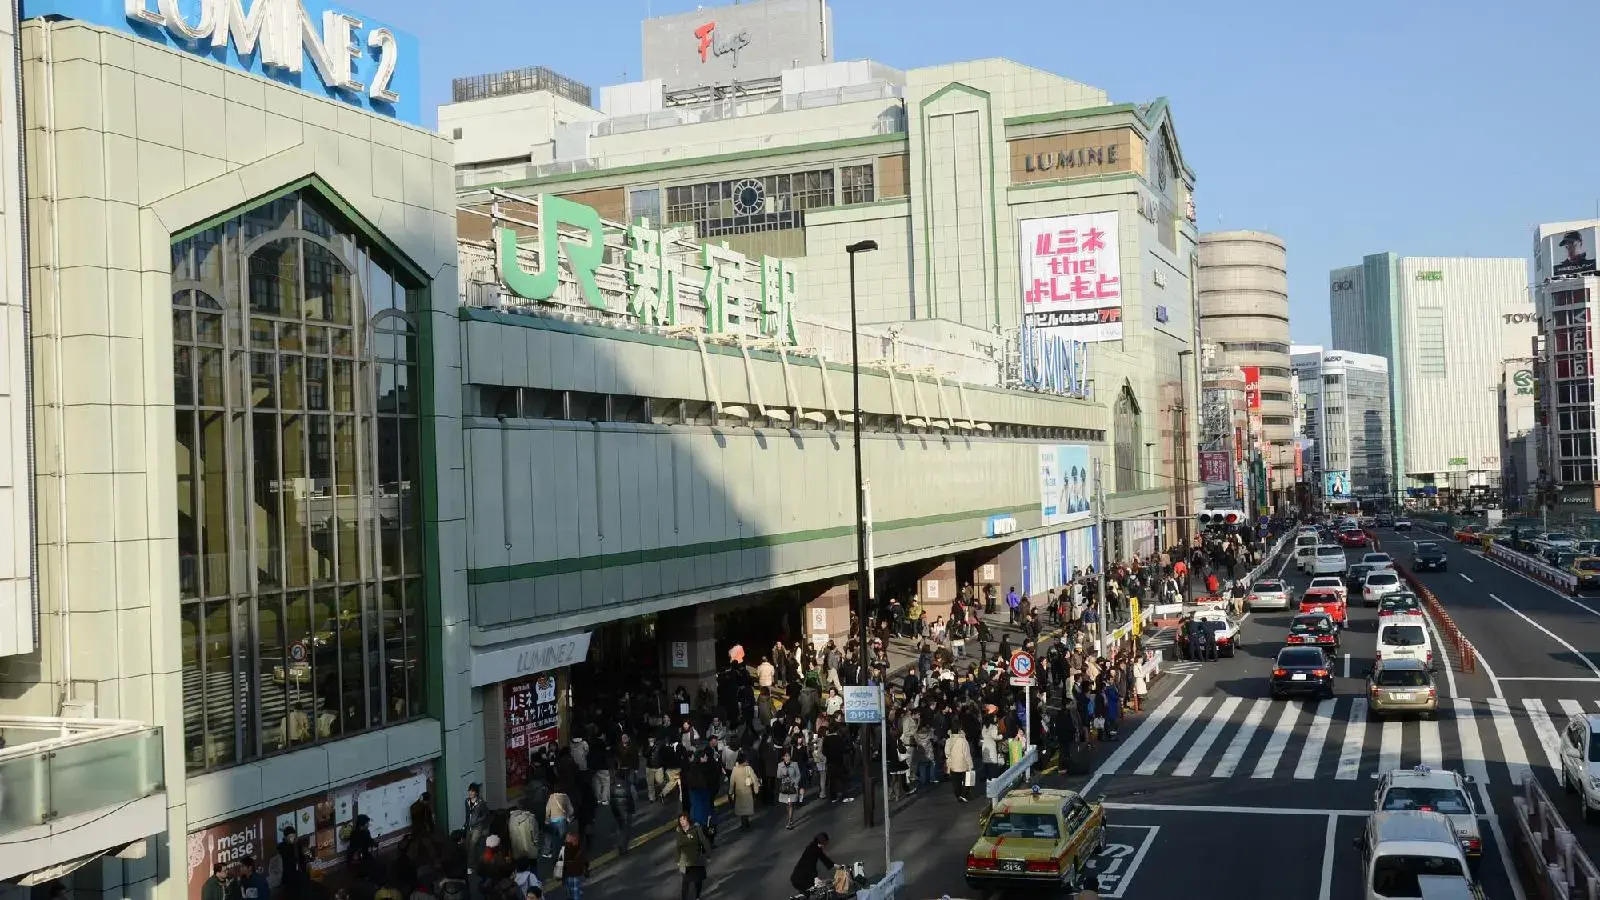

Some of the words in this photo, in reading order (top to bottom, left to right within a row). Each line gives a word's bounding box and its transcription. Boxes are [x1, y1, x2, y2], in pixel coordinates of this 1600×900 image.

[1025, 143, 1119, 173] LUMINE
[496, 193, 607, 310] JR
[1036, 227, 1105, 256] ルミネ
[1048, 256, 1097, 276] the
[1025, 274, 1120, 303] よしもと
[510, 691, 532, 711] ルミネ
[847, 700, 878, 709] タクシー
[849, 711, 875, 720] のりば
[217, 823, 256, 850] meshi
[217, 842, 254, 863] mase
